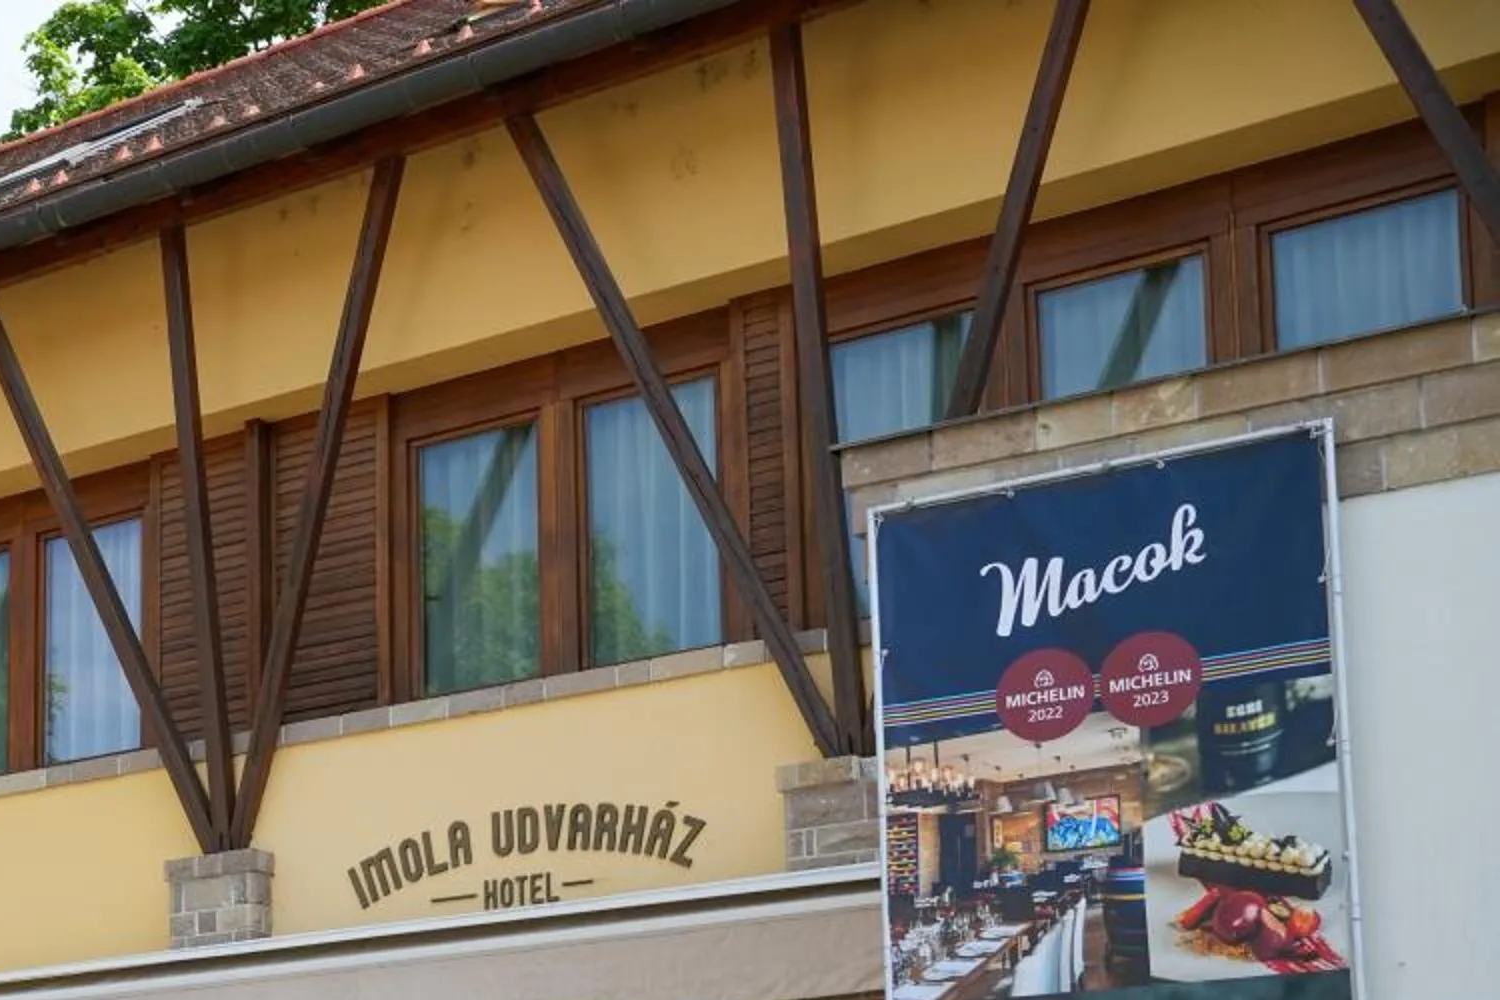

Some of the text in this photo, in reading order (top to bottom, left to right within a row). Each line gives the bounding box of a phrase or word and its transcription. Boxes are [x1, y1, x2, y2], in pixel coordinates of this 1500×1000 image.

[979, 503, 1207, 637] Macok
[1109, 669, 1192, 694] MICHELIN
[1005, 685, 1085, 709] MICHELIN
[1133, 690, 1169, 708] 2023
[1027, 706, 1063, 723] 2022
[347, 801, 707, 910] IMOLA UDVARHÁZ
[483, 871, 560, 911] HOTEL
